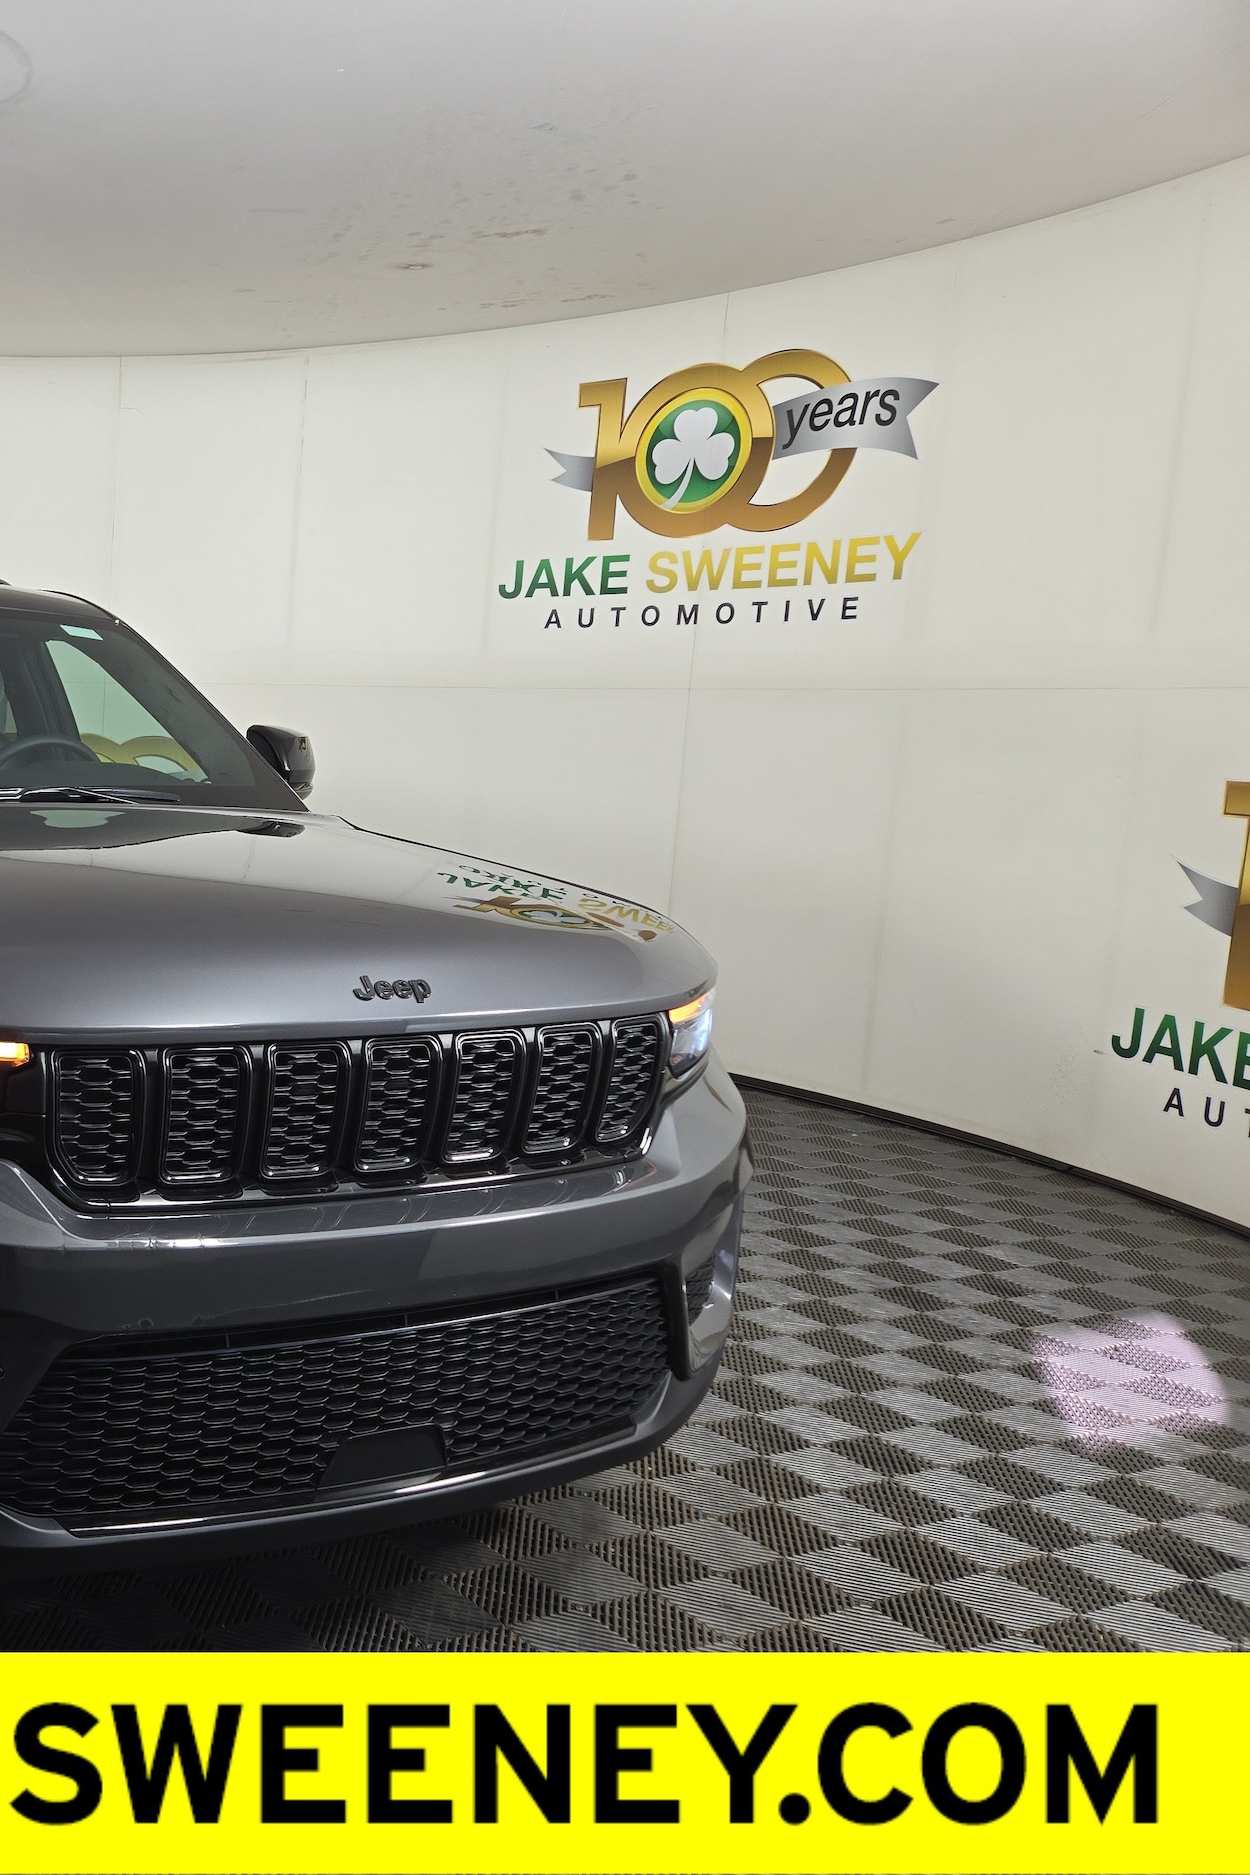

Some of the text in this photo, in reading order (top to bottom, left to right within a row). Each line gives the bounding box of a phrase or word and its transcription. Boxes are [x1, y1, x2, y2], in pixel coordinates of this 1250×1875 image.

[578, 348, 900, 541] 100 years
[499, 532, 922, 599] JAKE SWEENEY
[544, 596, 859, 630] AUTOMOTIVE
[352, 975, 432, 1003] Jeep
